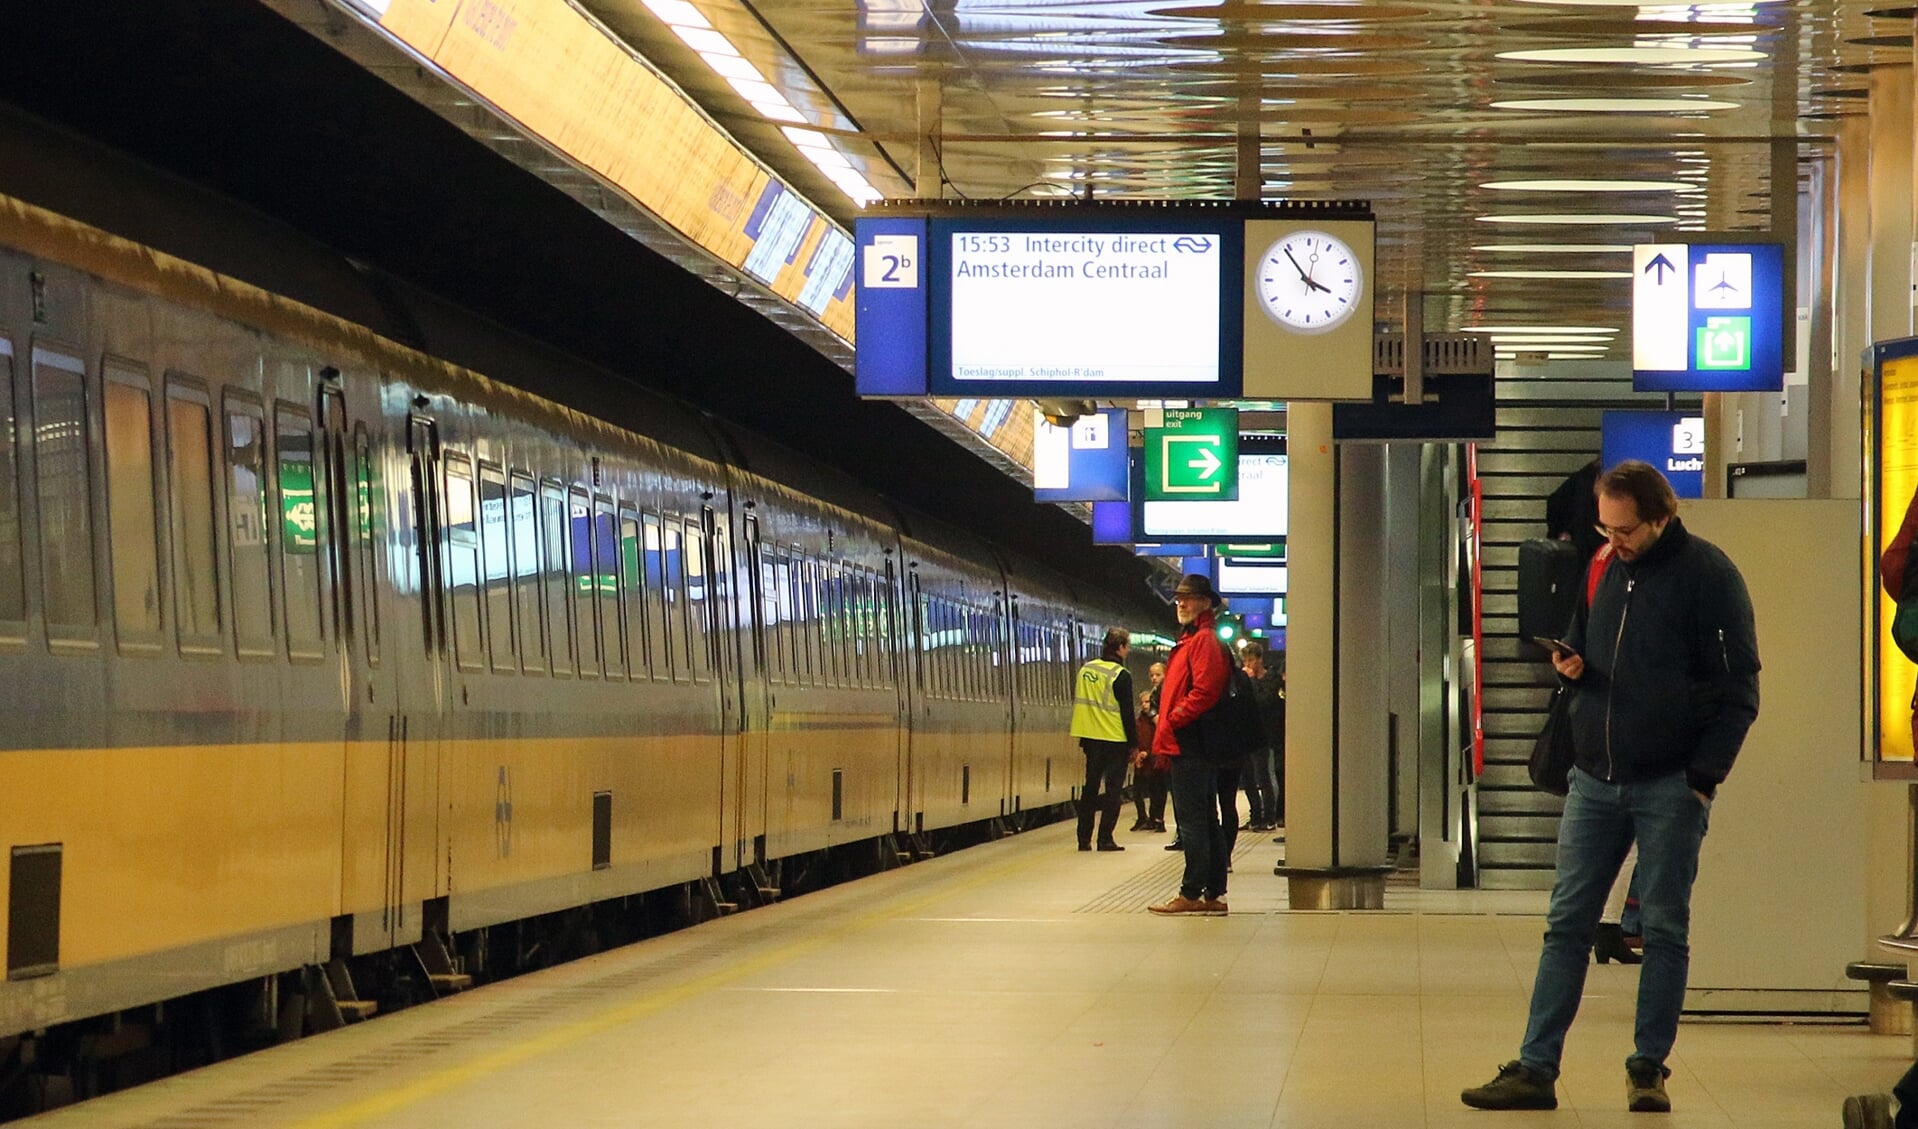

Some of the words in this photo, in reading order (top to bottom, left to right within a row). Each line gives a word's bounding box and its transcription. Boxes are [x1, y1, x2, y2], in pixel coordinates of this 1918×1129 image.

[960, 236, 1010, 253] 15:53
[1026, 236, 1105, 258] Intercity
[1111, 235, 1167, 253] direct
[957, 259, 1075, 278] Amsterdam
[1082, 260, 1168, 279] Centraal
[958, 367, 1027, 378] Toeslag/suppl.
[1029, 367, 1105, 378] Schiphol-R'dam
[1166, 410, 1203, 420] uitgang
[1165, 420, 1182, 428] exit
[1239, 457, 1262, 466] rect
[1239, 470, 1264, 479] raal
